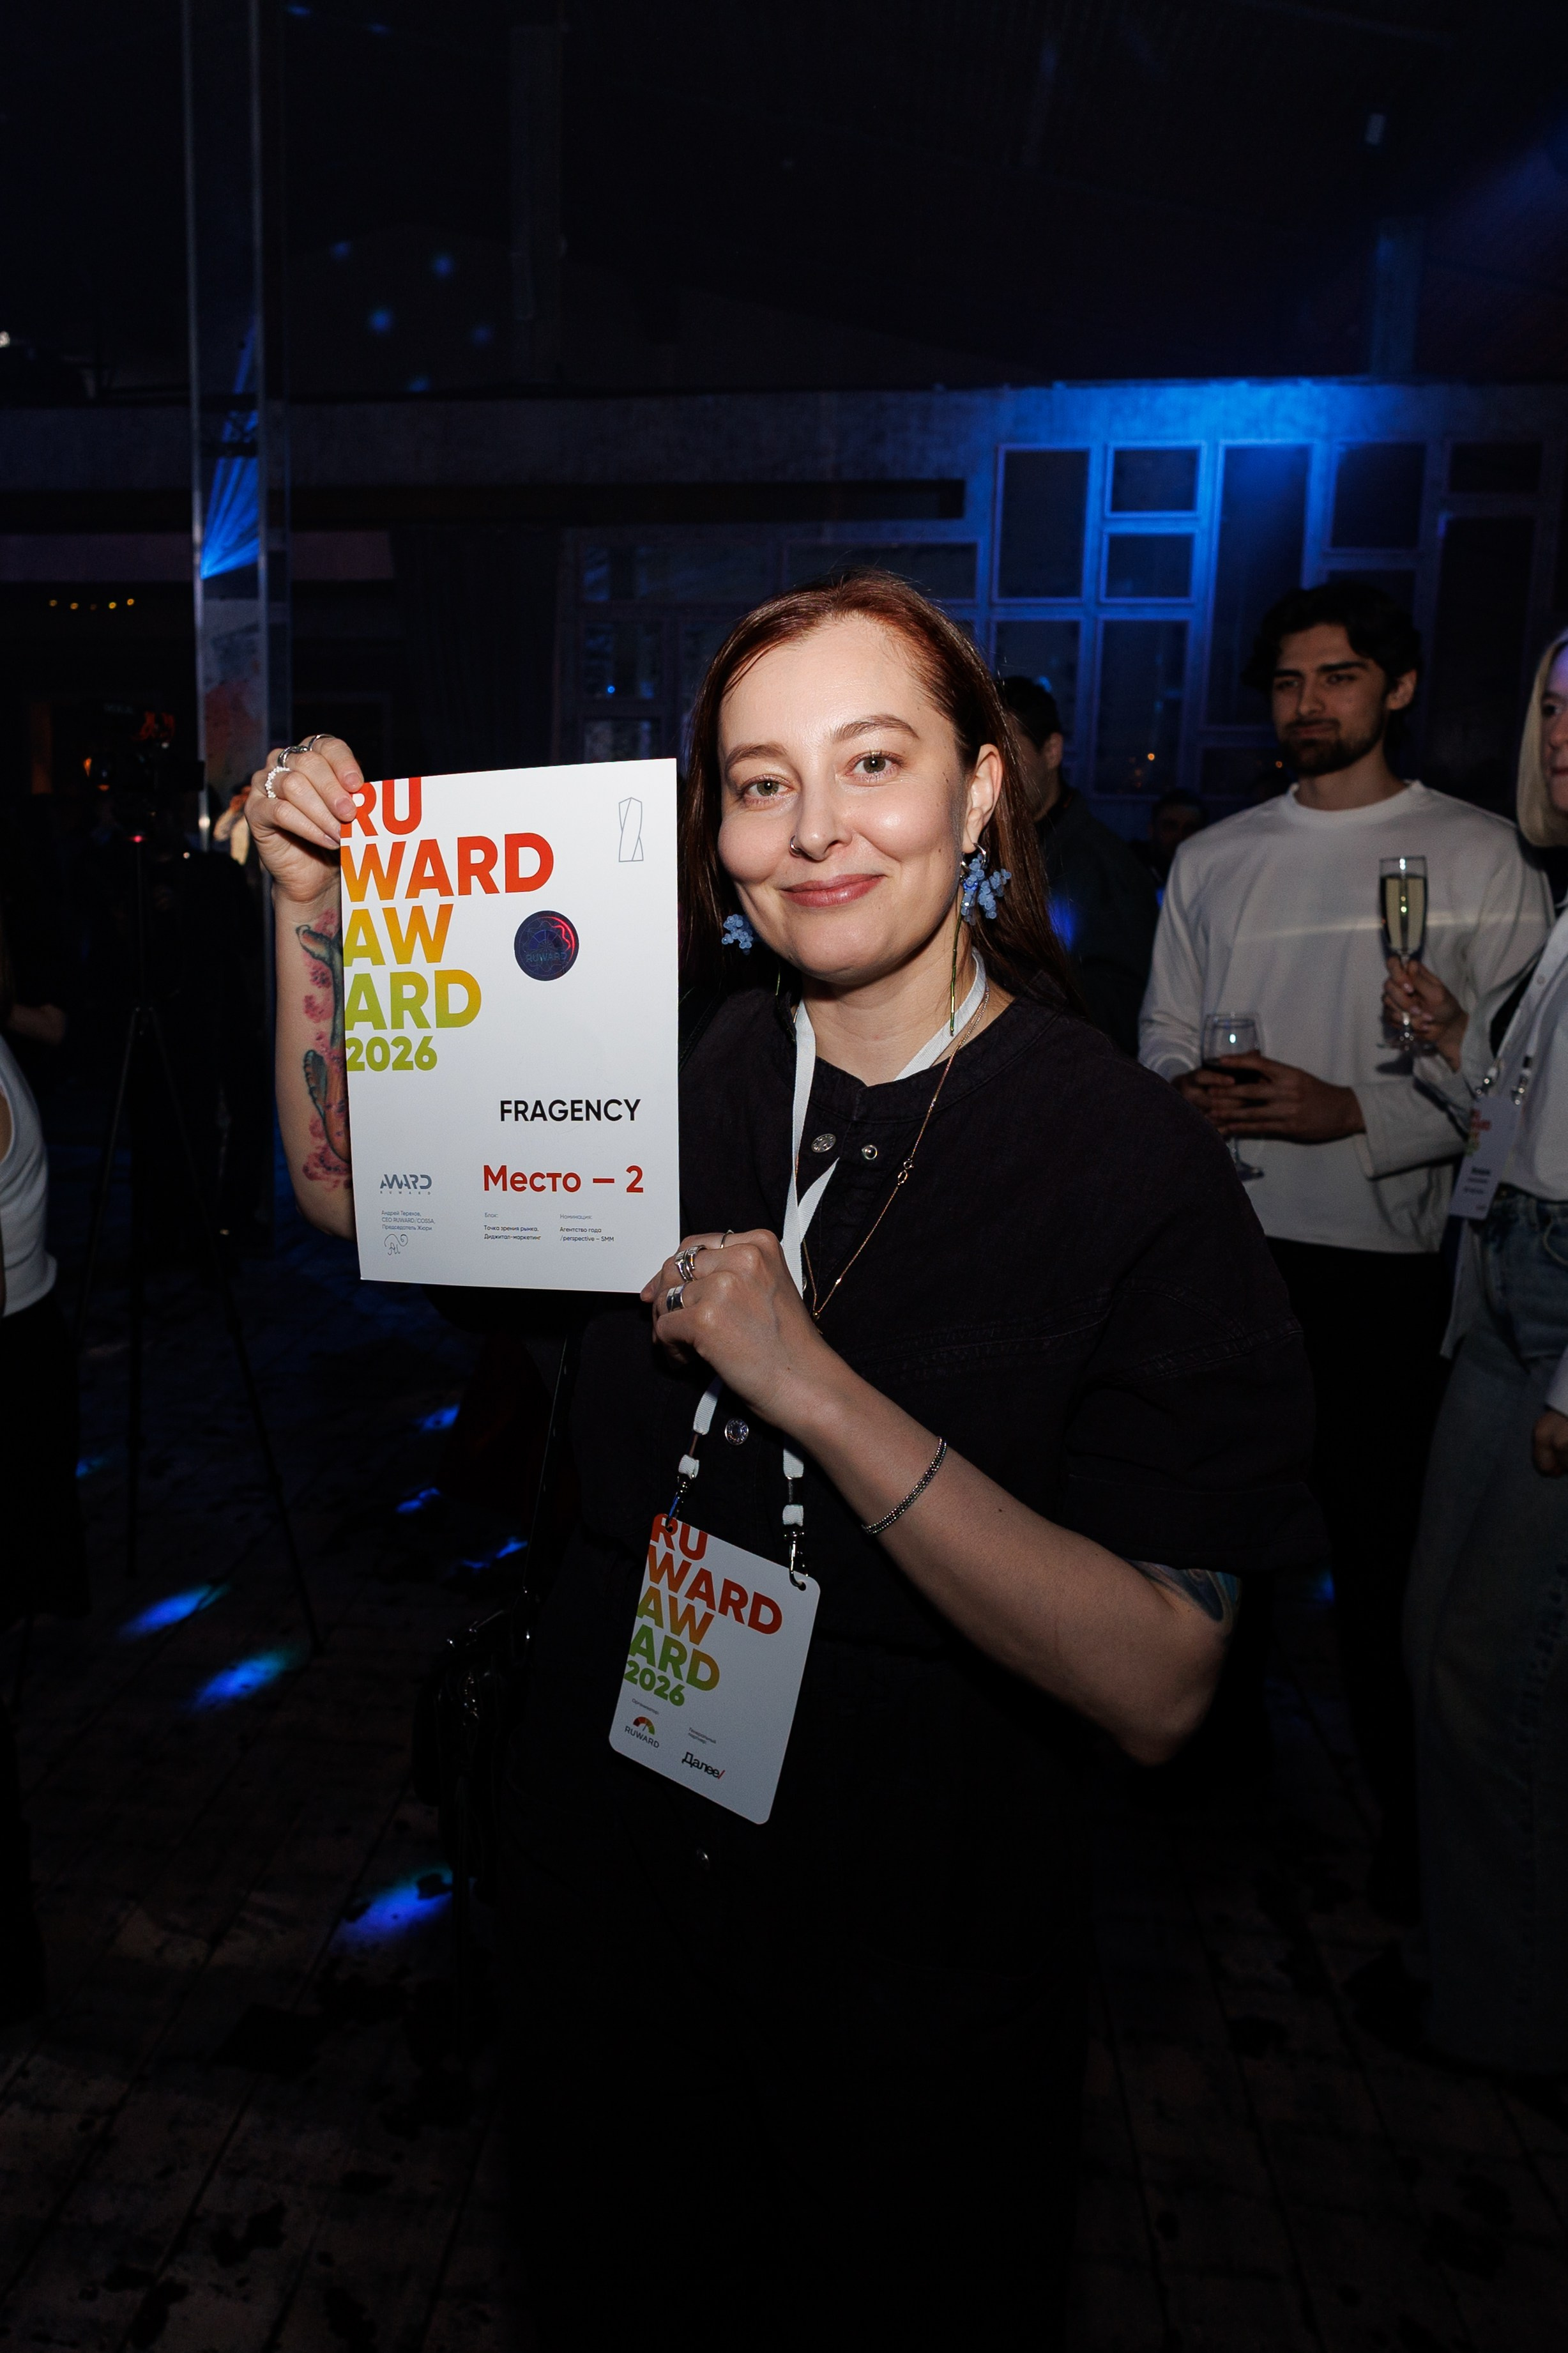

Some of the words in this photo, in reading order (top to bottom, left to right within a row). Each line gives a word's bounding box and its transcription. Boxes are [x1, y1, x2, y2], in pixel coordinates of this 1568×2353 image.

[341, 777, 422, 838] RU
[340, 832, 554, 902] WARD
[343, 903, 454, 967] AW
[345, 969, 482, 1031] ARD
[346, 1036, 438, 1072] 2026
[500, 1099, 641, 1122] FRAGENCY
[380, 1174, 432, 1190] AWARD
[483, 1165, 581, 1193] Место
[625, 1165, 644, 1193] 2
[650, 1514, 708, 1561] RU
[637, 1585, 715, 1646] AW
[647, 1545, 782, 1635] WARD
[623, 1660, 685, 1707] 2026
[629, 1625, 720, 1692] ARD
[624, 1726, 660, 1749] RUWARD
